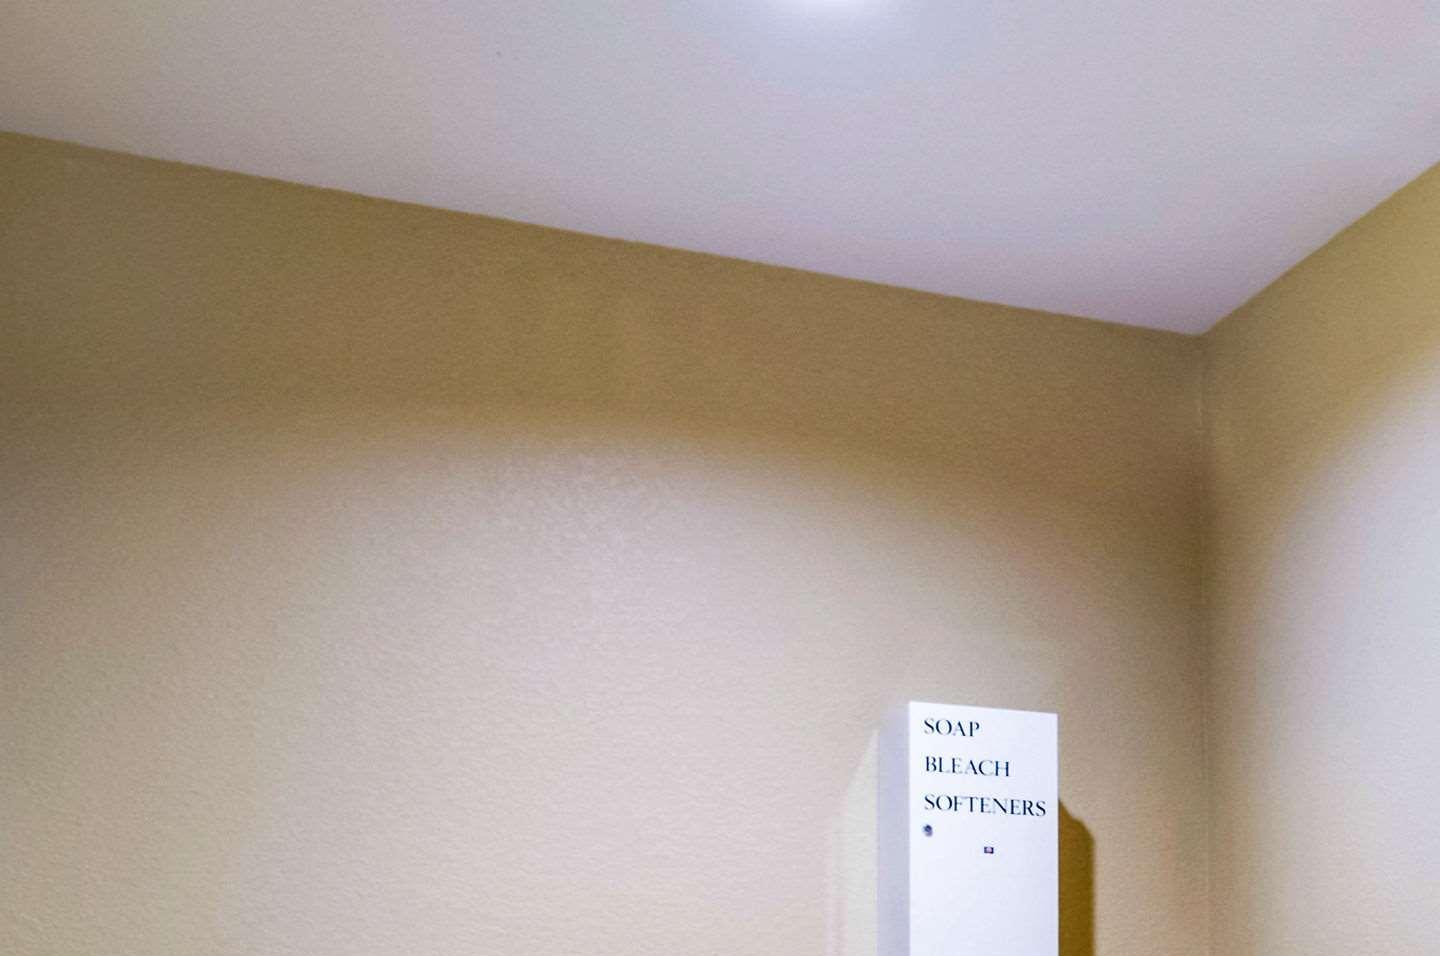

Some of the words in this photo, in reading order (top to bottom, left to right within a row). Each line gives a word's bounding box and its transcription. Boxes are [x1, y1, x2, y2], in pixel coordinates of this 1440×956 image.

[923, 717, 980, 737] SOAP
[925, 756, 1010, 777] BLEACH
[923, 793, 1047, 817] SOFTENERS
